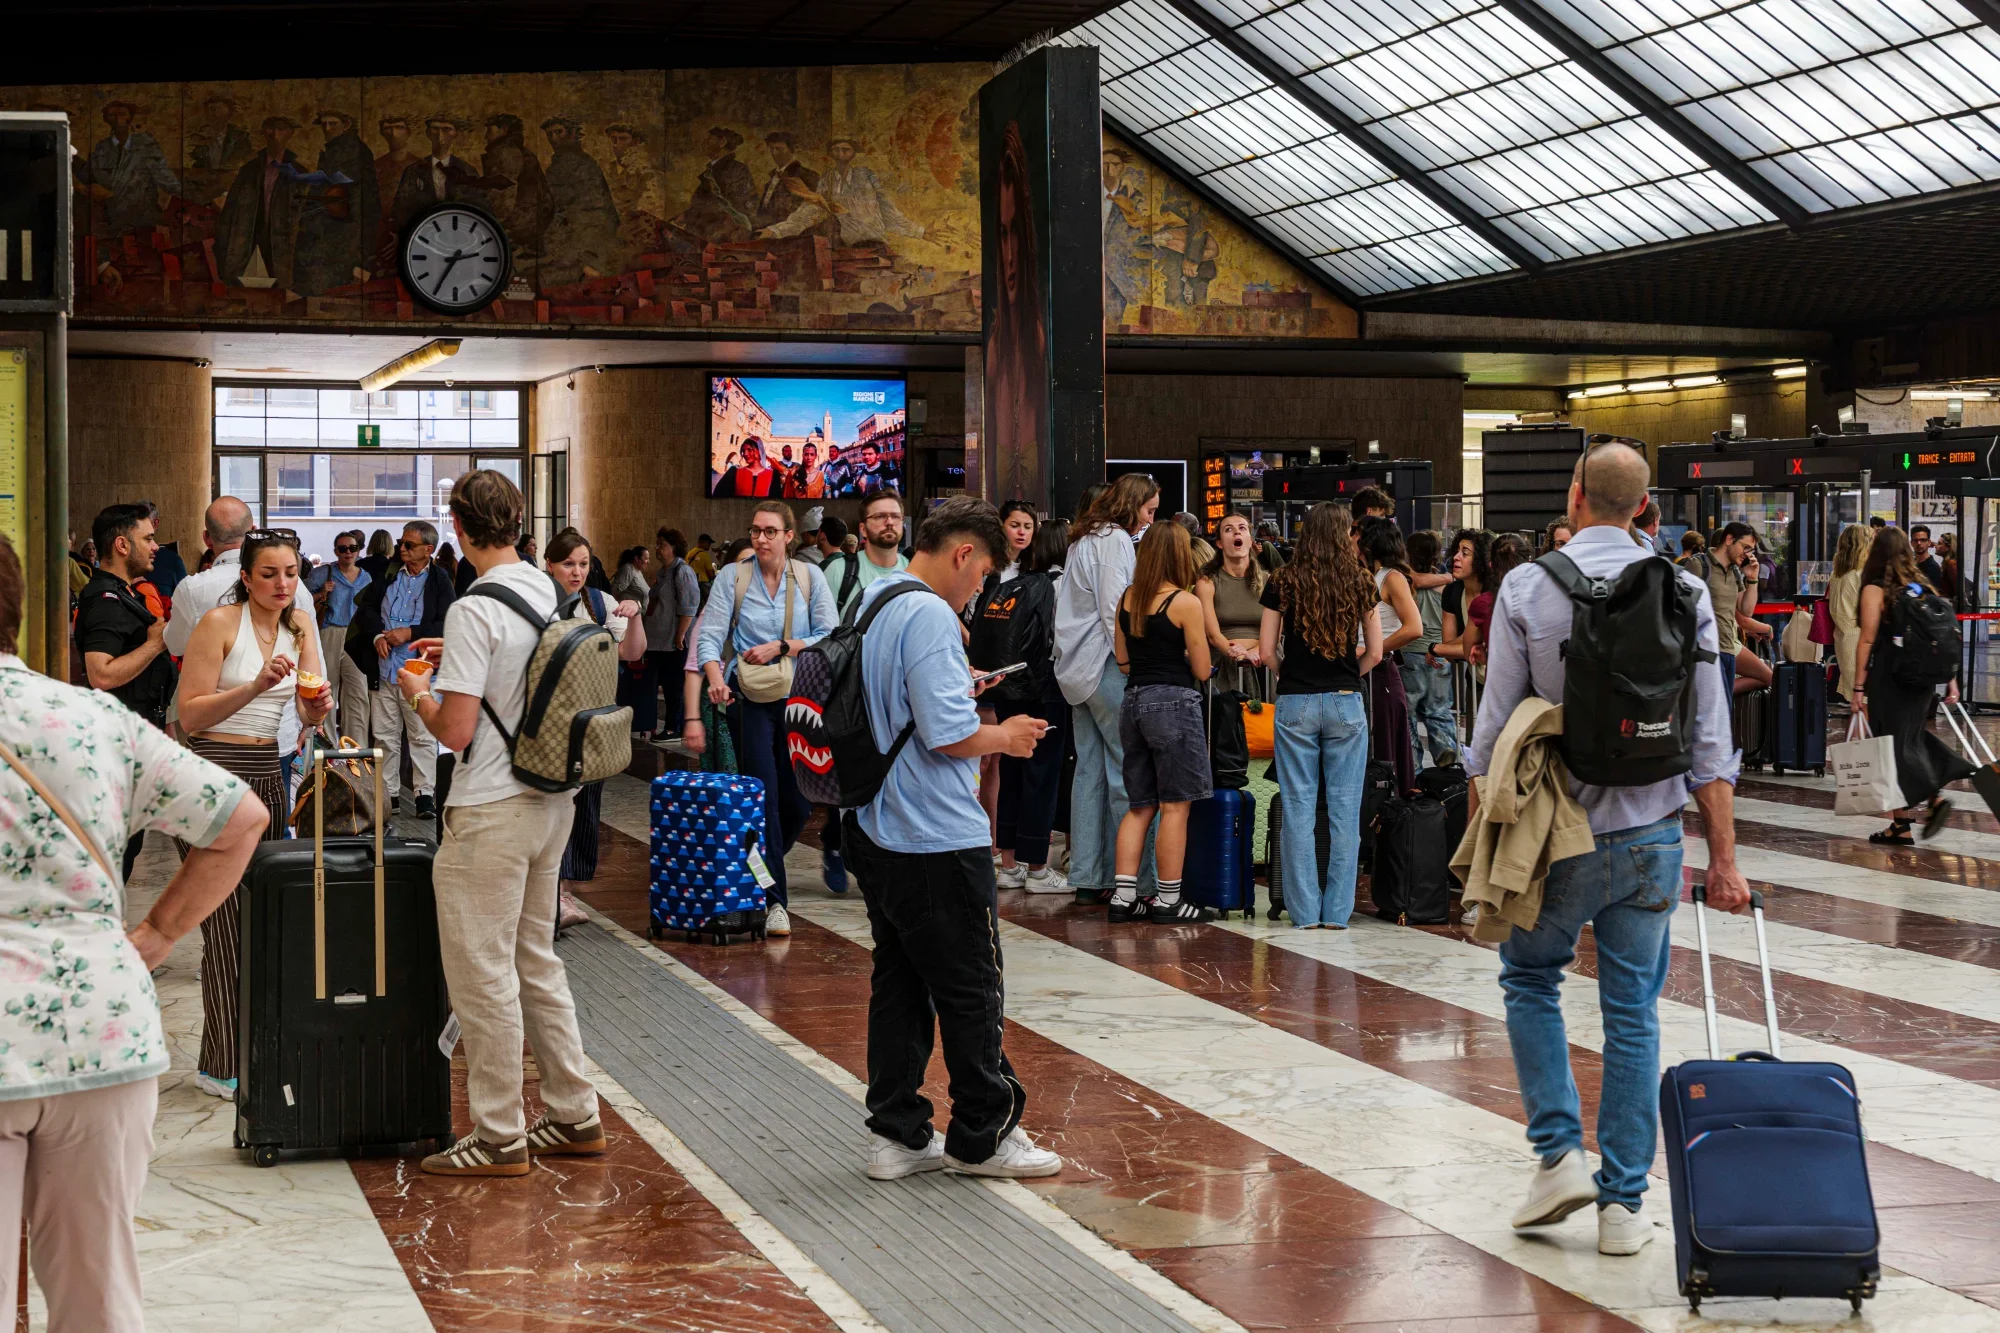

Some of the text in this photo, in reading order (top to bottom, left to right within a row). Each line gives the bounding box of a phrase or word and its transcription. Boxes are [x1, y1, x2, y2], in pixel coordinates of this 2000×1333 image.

[1949, 452, 1976, 463] ENTRATA
[1232, 489, 1263, 498] PIZZA TAKE
